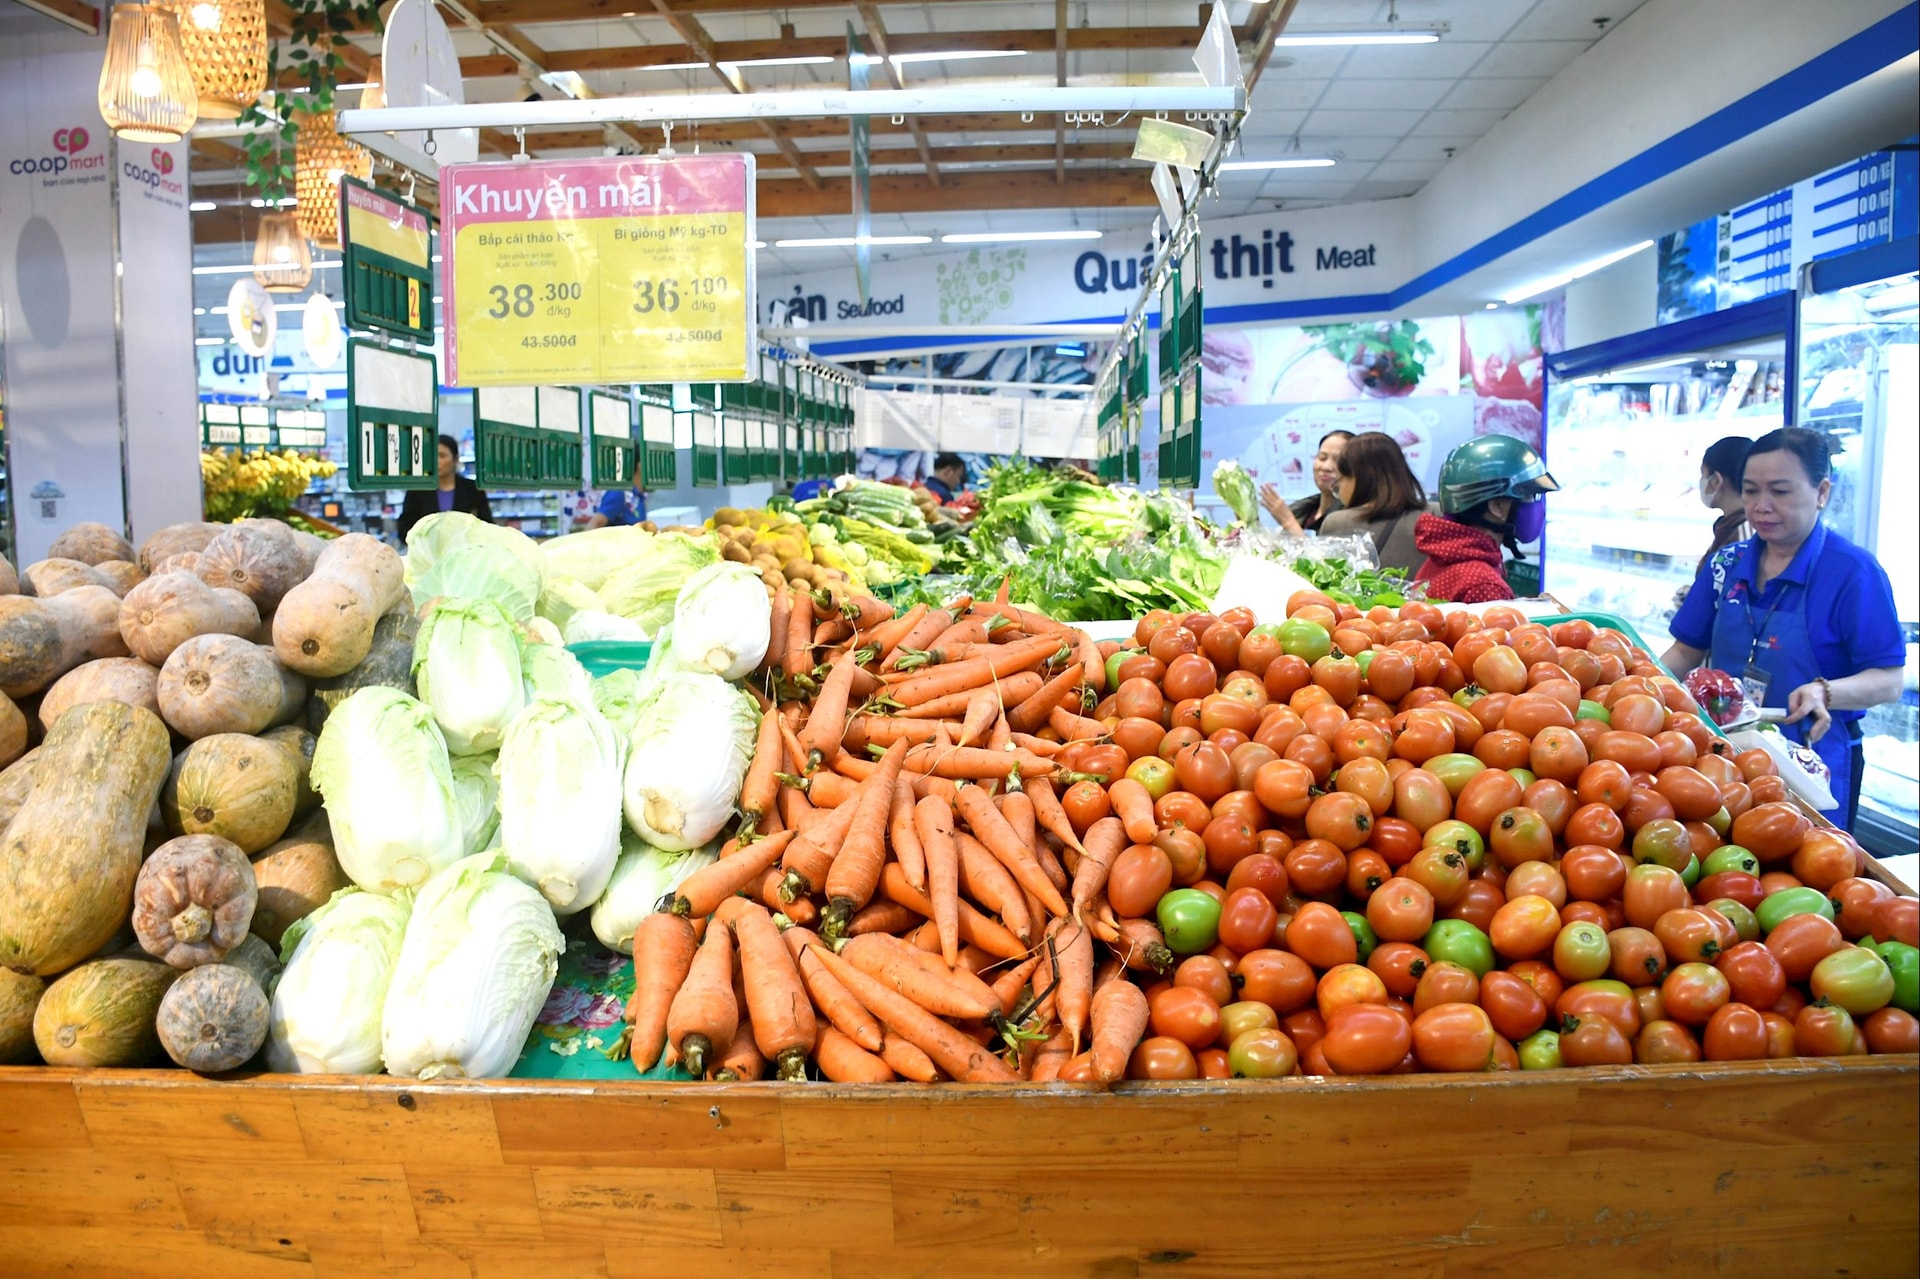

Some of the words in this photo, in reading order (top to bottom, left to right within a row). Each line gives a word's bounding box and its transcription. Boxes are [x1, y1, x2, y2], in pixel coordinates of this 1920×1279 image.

[455, 173, 587, 219] Khuyến
[527, 231, 553, 244] thảo
[1210, 229, 1294, 288] thịt
[1316, 243, 1376, 271] Meat
[413, 434, 420, 465] 8
